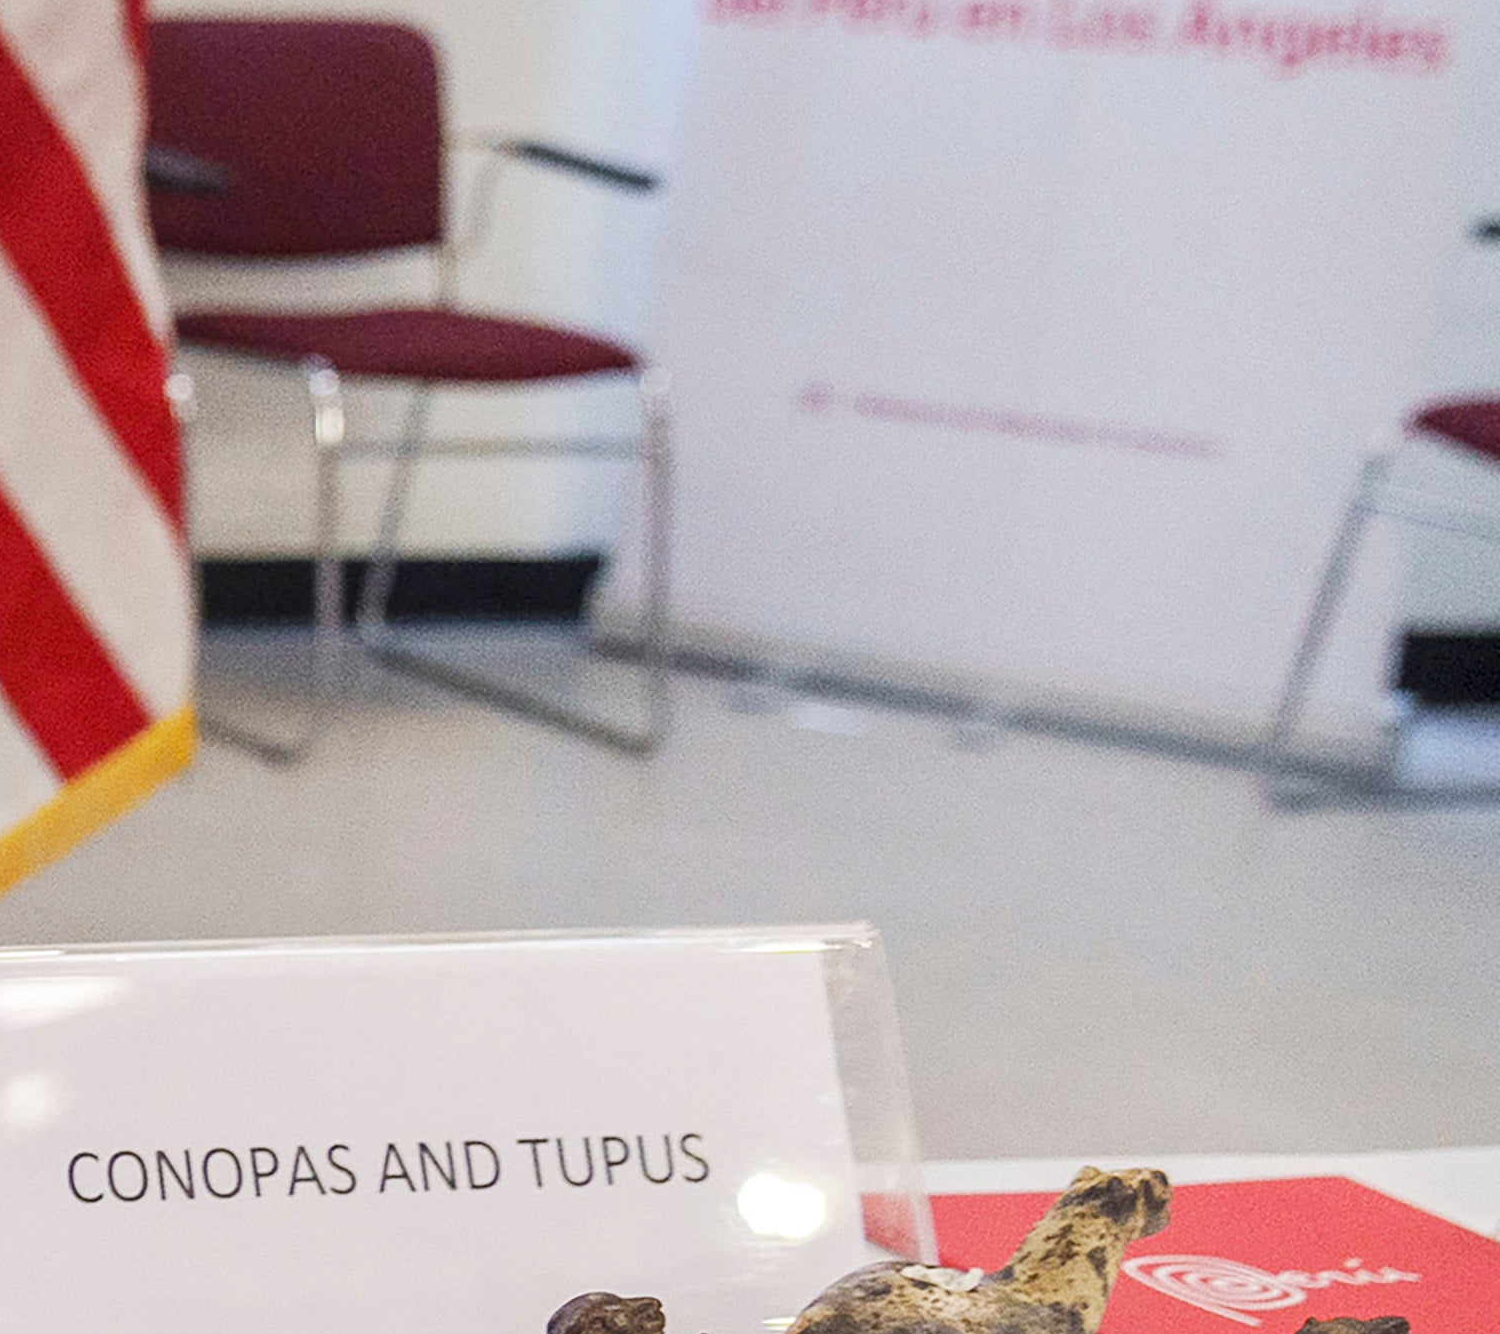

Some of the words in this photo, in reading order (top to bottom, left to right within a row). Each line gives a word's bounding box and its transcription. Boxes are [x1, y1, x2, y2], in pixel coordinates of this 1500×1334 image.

[66, 1142, 358, 1205] CONOPAS
[378, 1139, 502, 1194] AND
[516, 1132, 711, 1189] TUPUS
